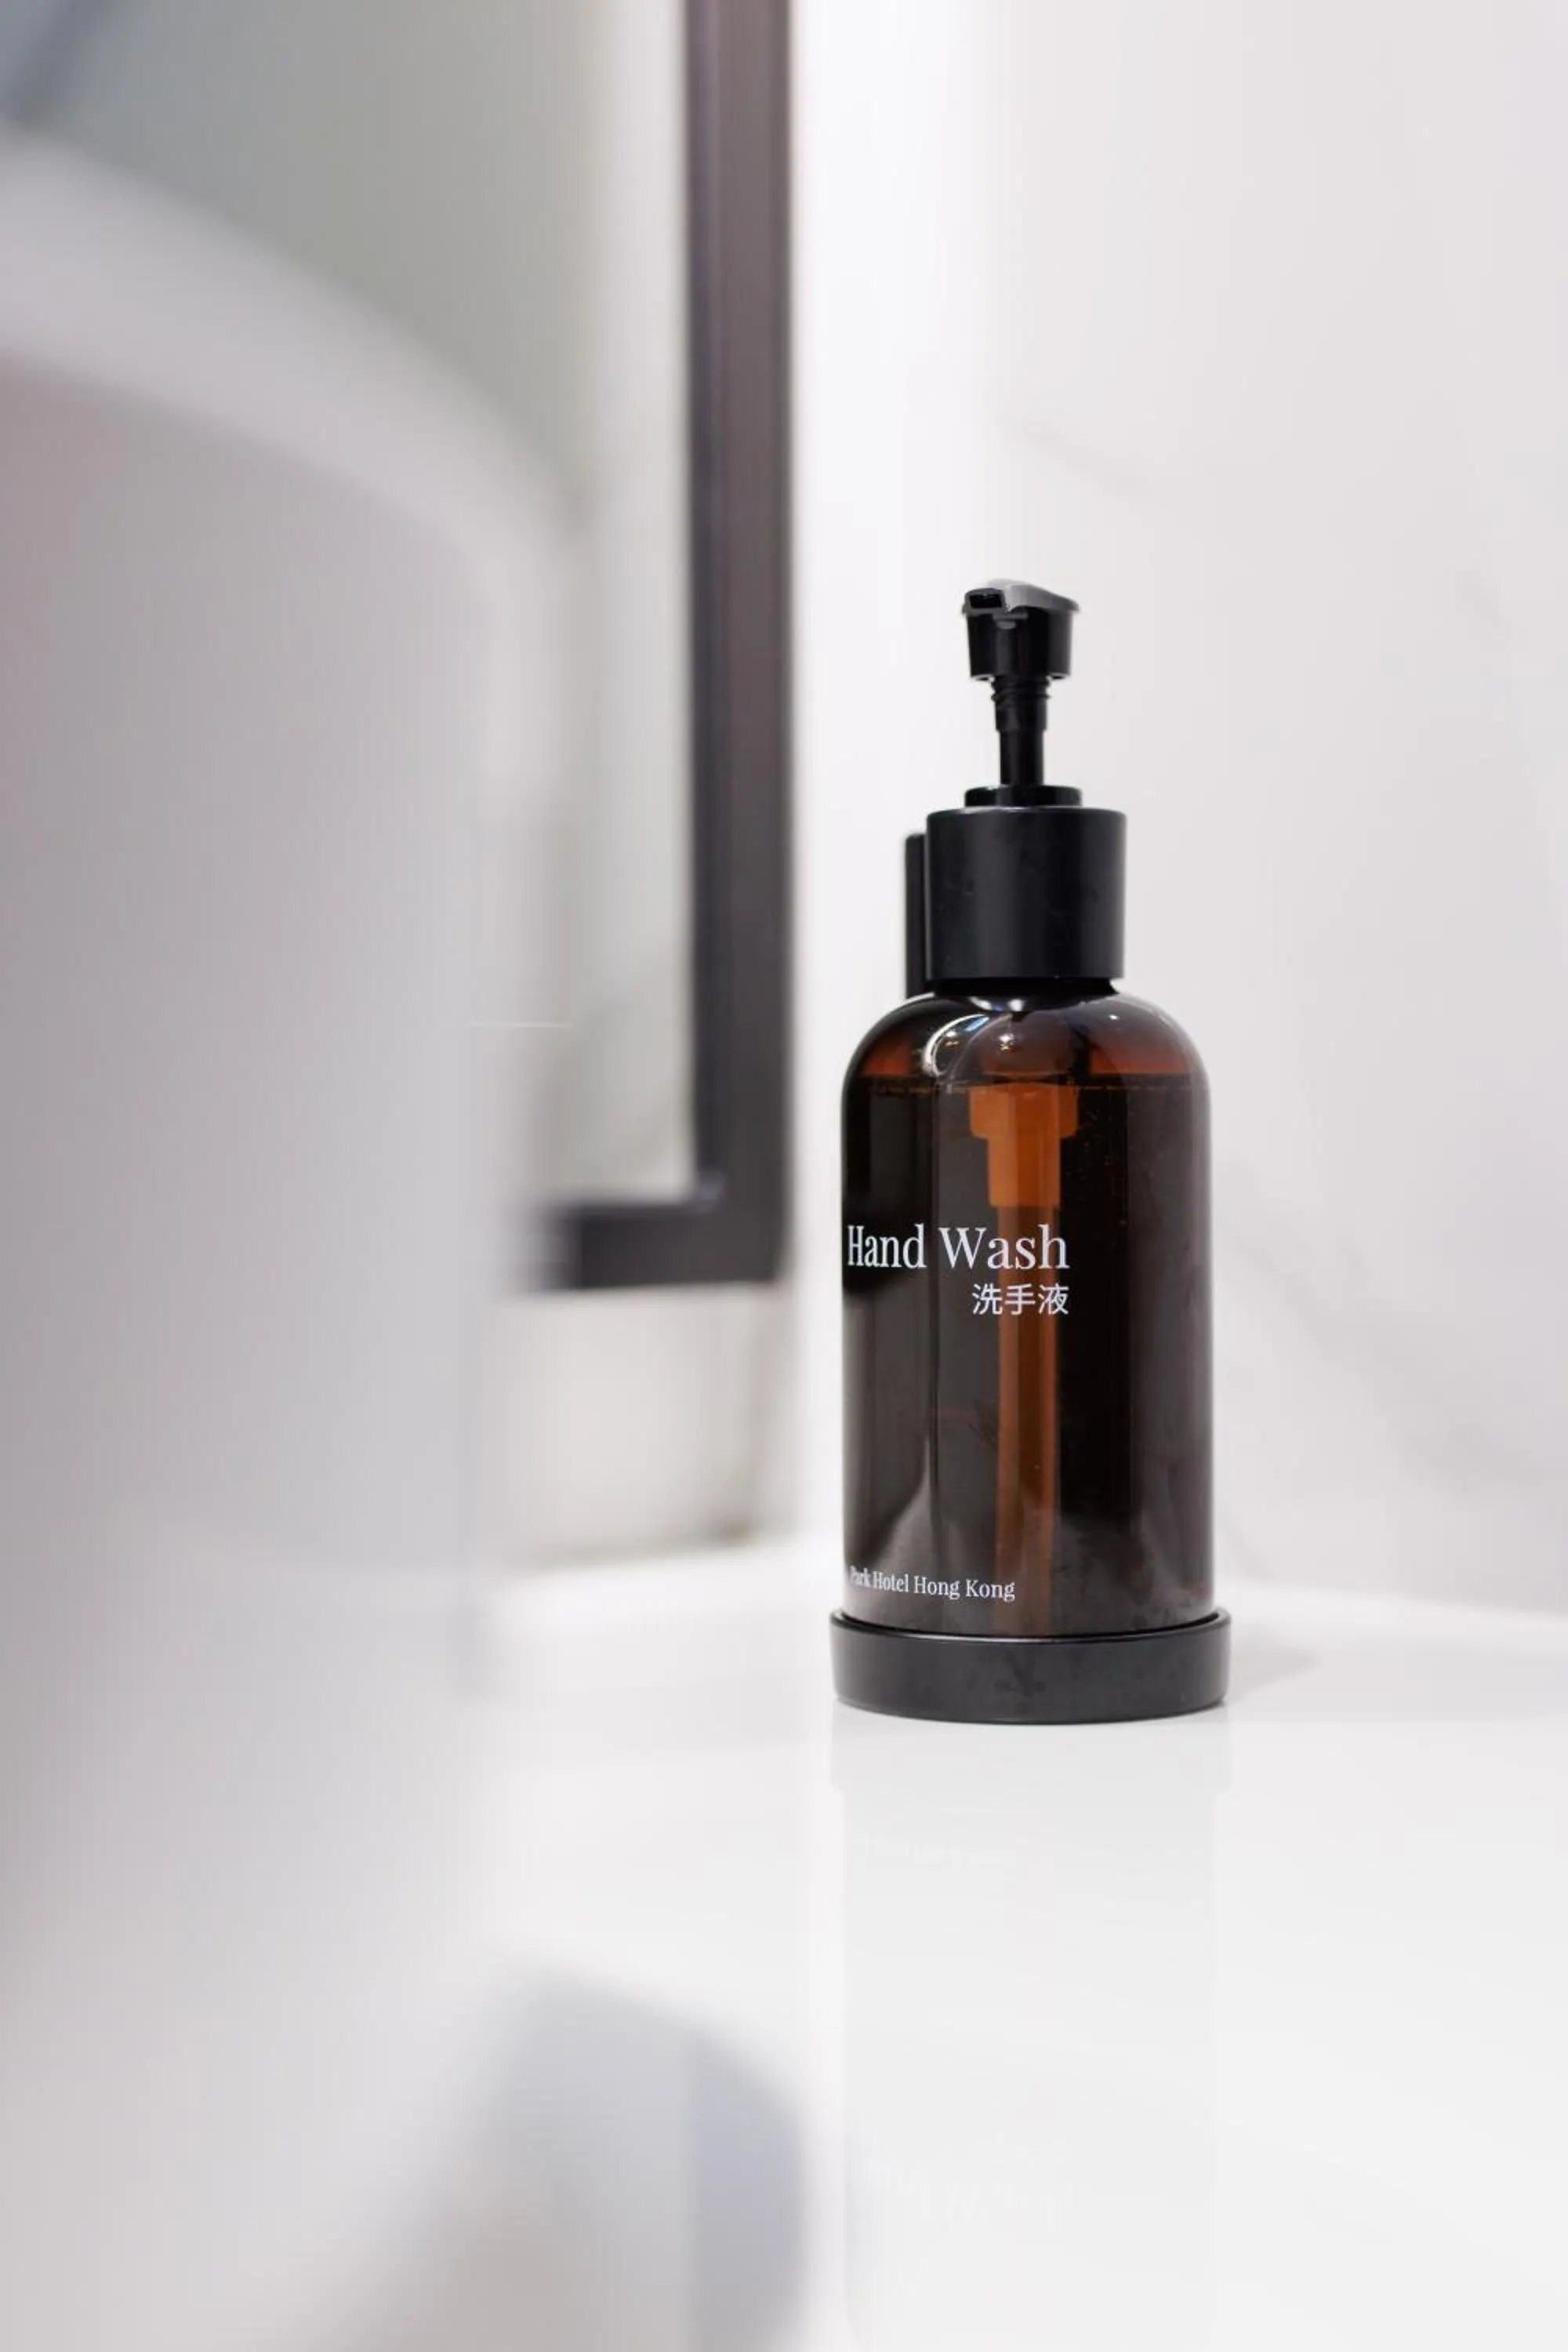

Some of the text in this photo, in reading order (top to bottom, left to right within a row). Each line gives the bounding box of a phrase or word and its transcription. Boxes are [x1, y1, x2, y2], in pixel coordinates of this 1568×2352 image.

[848, 1223, 1070, 1269] Hand Wash
[971, 1283, 1069, 1316] 洗手液
[873, 1570, 909, 1592] Hotel
[913, 1575, 960, 1600] Hong
[965, 1578, 1016, 1602] Kong
